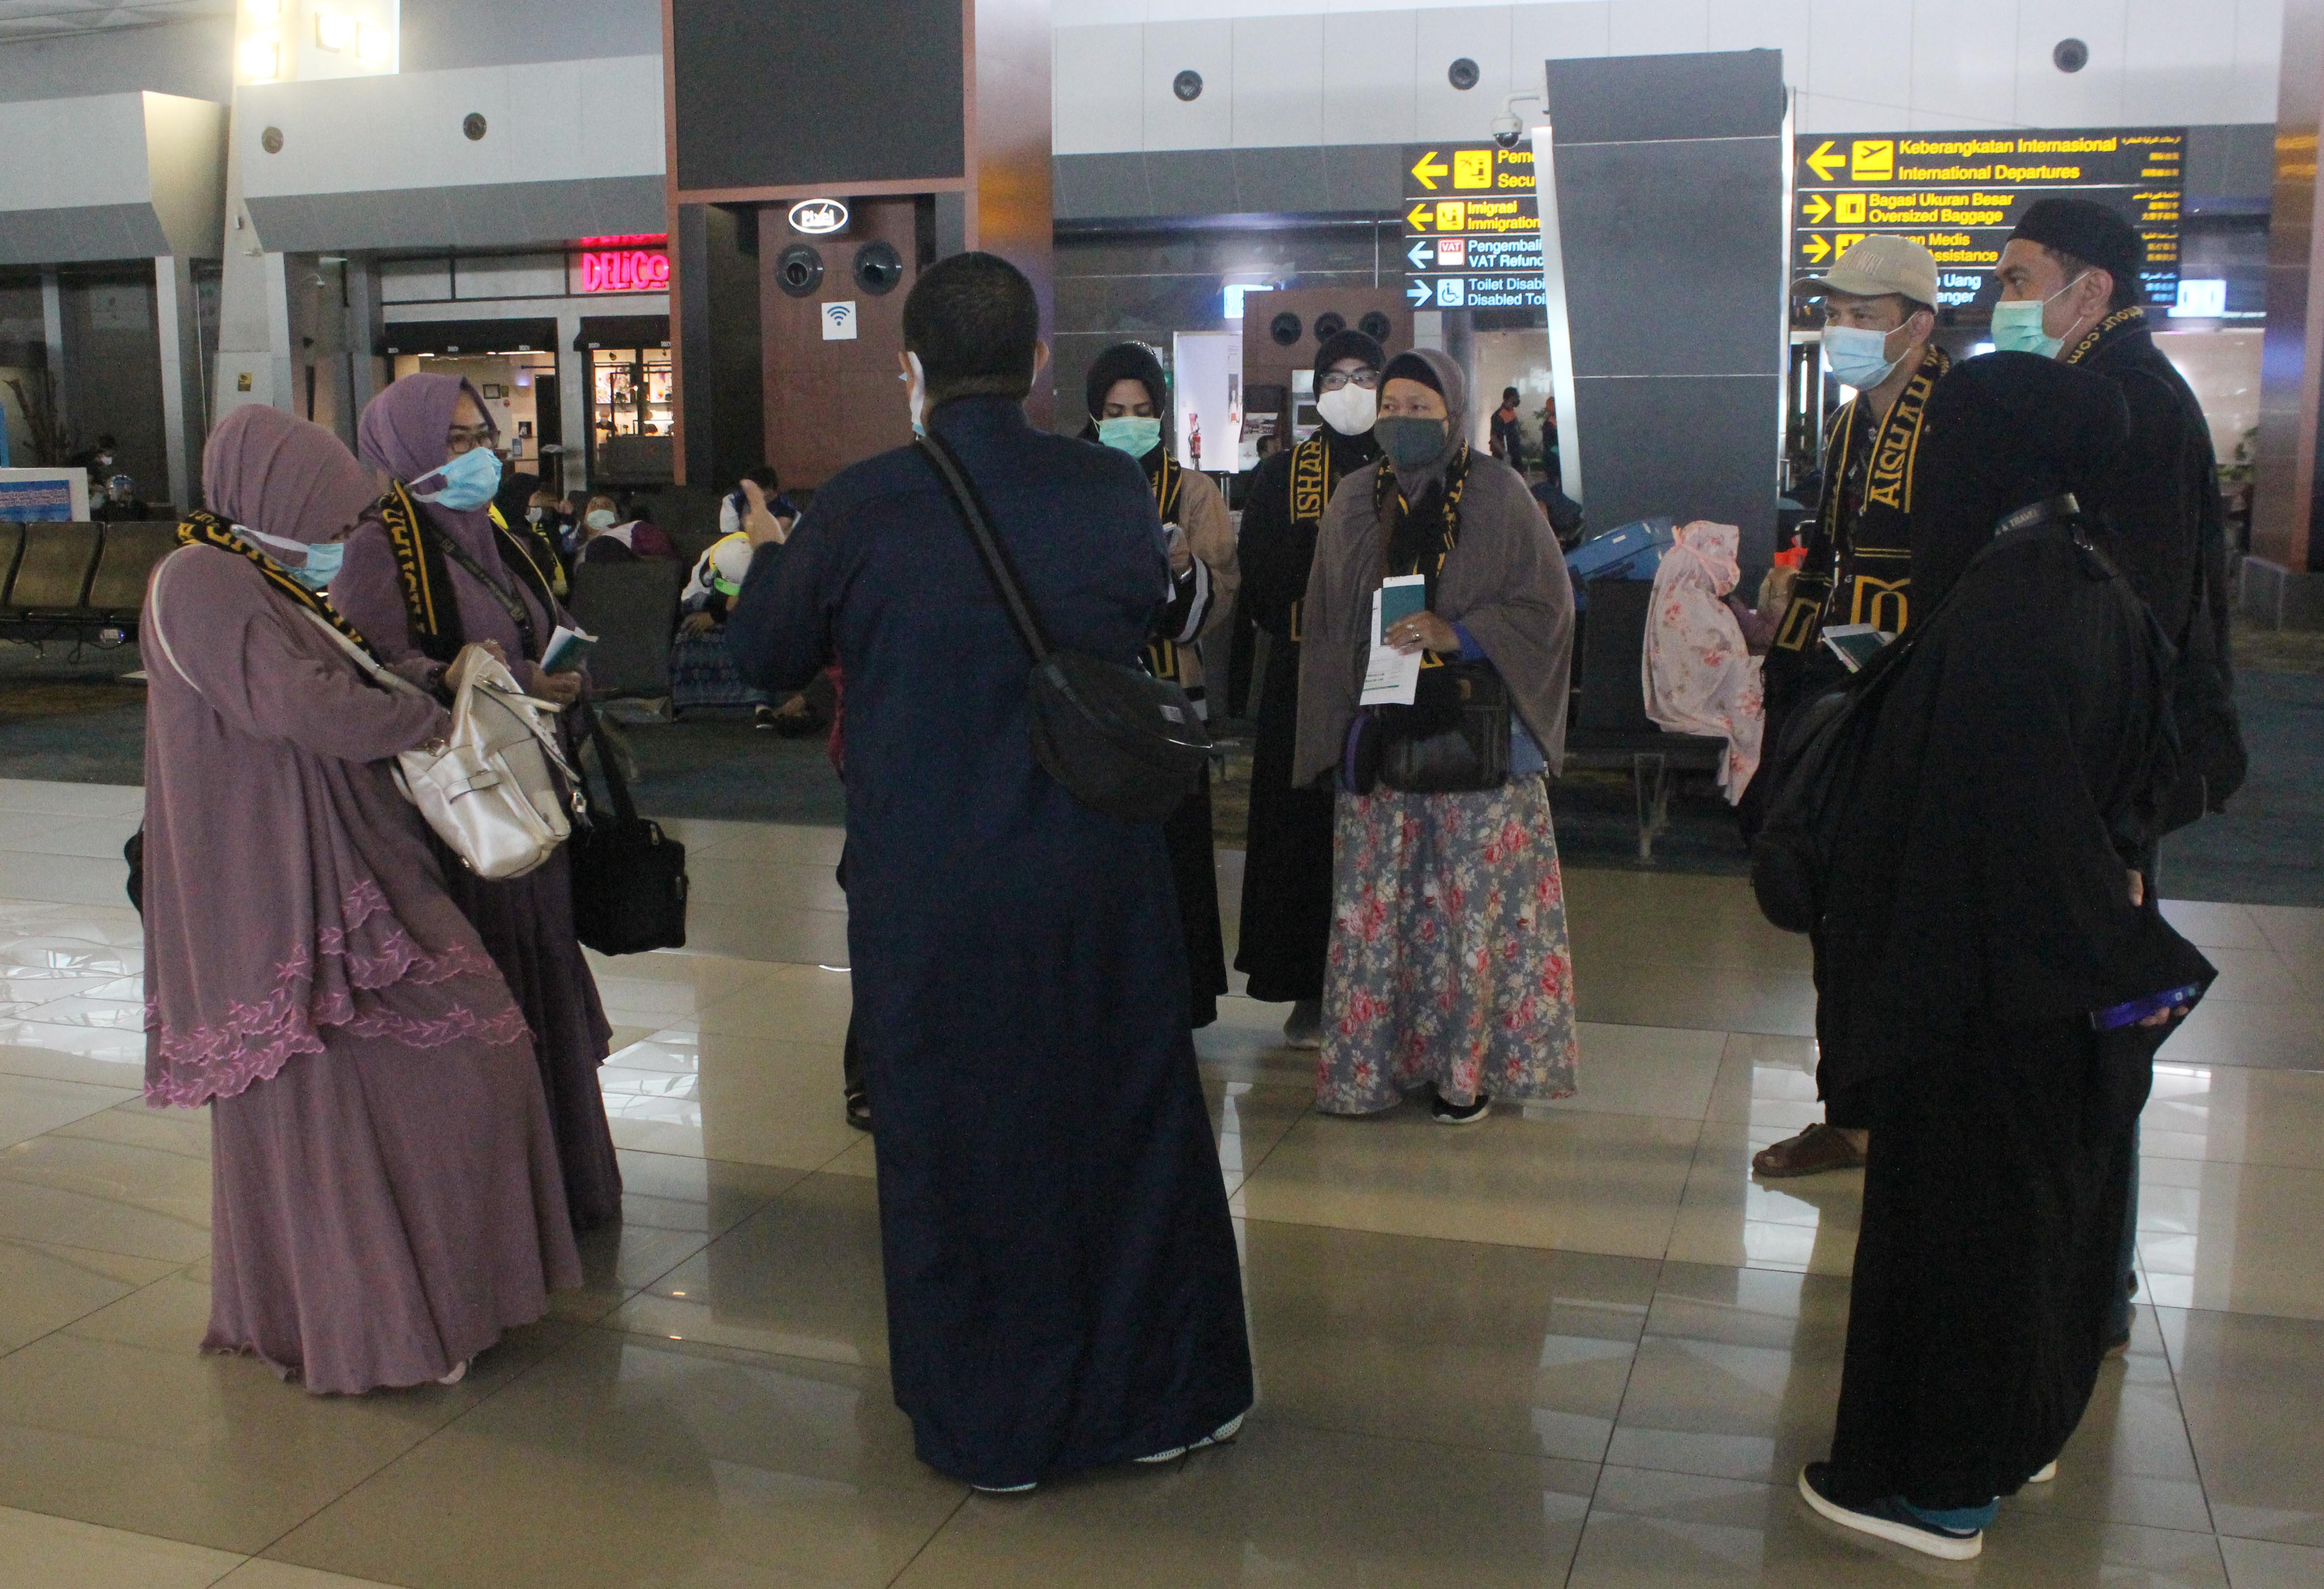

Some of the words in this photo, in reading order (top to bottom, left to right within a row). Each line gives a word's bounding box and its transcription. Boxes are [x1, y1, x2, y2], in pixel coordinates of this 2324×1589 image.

[1898, 139, 2015, 157] Keberangkatan
[2017, 137, 2117, 153] Internasional
[1497, 149, 1535, 164] Pem
[1497, 173, 1536, 188] Secu
[1898, 165, 1992, 180] International
[1994, 164, 2081, 182] Departures
[1467, 200, 1518, 217] Imigrasi
[1869, 193, 1916, 210] Bagasi
[1919, 192, 1969, 207] Ukuran
[1971, 192, 2015, 206] Besar
[1467, 216, 1541, 232] Immigration
[1869, 209, 1939, 223] Oversized
[1941, 209, 2004, 225] Baggage
[1442, 243, 1461, 251] VAT
[1468, 238, 1542, 255] Pengembali
[1928, 233, 1971, 246] Medis
[1469, 255, 1496, 268] VAT
[1469, 278, 1503, 291] Toilet
[1506, 277, 1545, 290] Disabi
[1943, 274, 1982, 290] Uang
[1468, 293, 1522, 306] Disabled
[1936, 292, 1976, 306] anger
[1297, 441, 1322, 520] ISHAH
